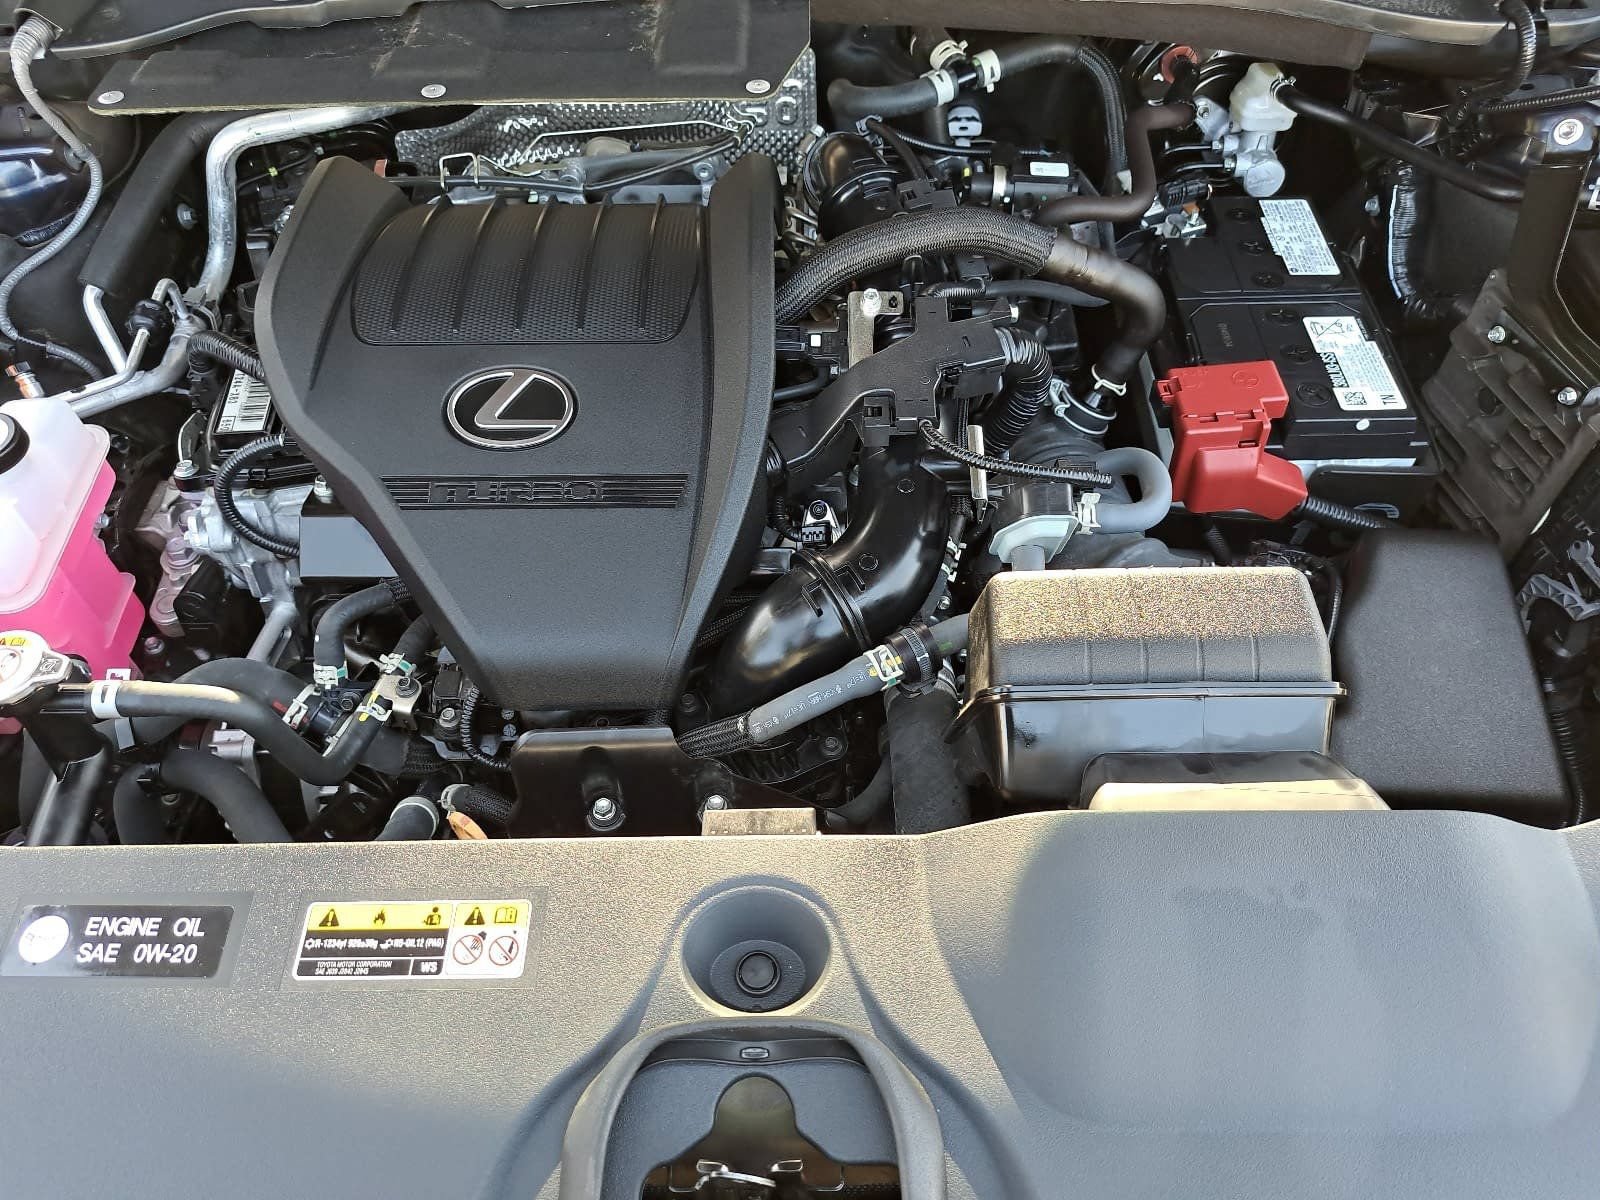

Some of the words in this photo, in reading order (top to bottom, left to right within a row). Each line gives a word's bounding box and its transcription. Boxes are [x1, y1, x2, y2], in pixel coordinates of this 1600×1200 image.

[428, 480, 603, 503] TURBO
[84, 917, 162, 937] ENGINE
[173, 917, 205, 937] OIL
[76, 943, 121, 963] SAE
[133, 943, 198, 963] 0W-20
[356, 960, 393, 968] CORPORATION
